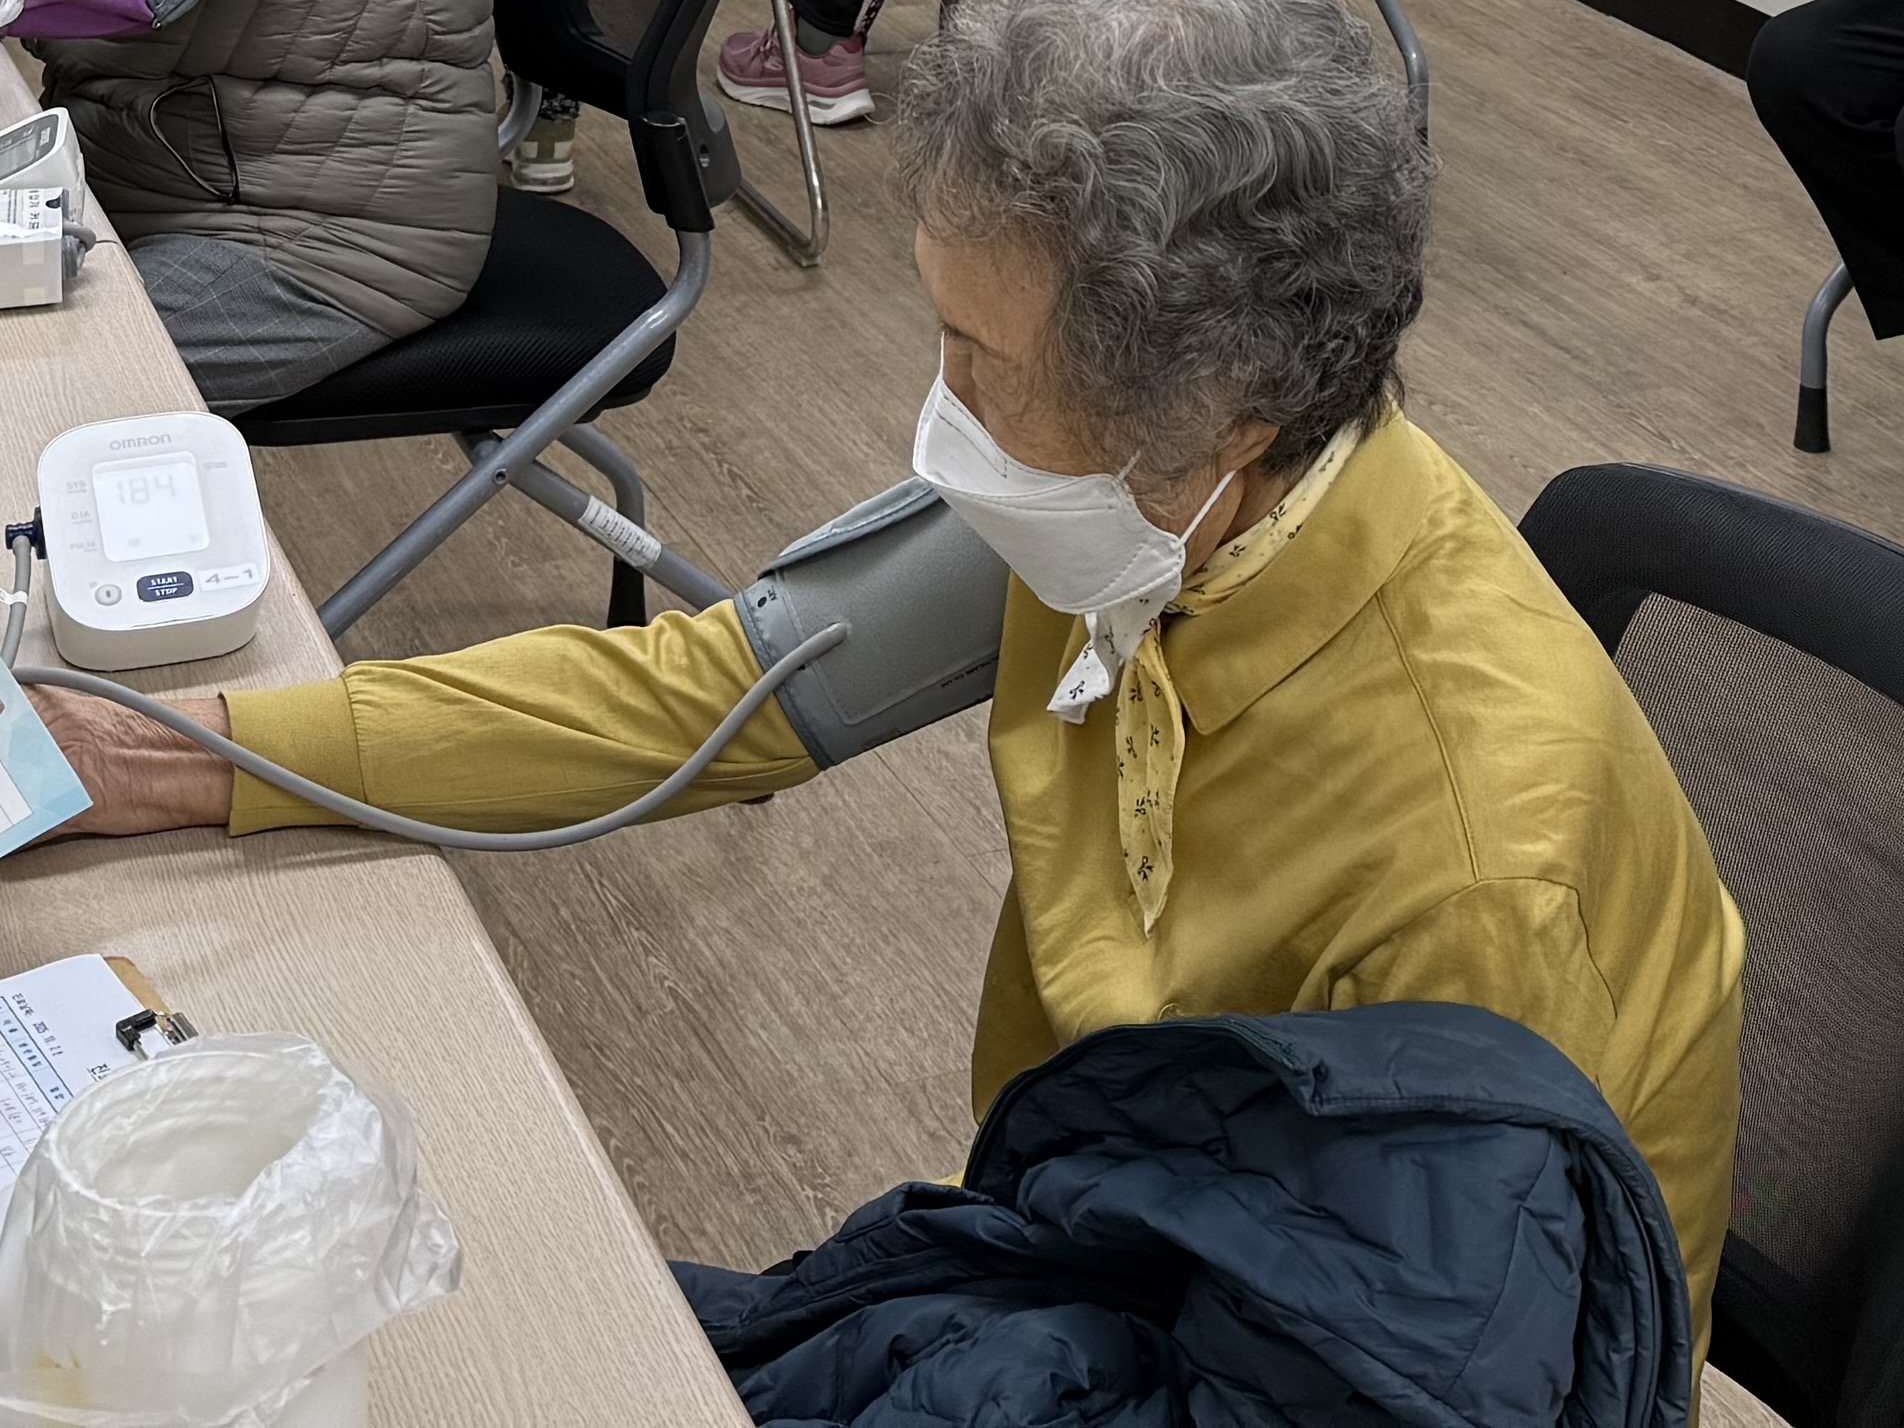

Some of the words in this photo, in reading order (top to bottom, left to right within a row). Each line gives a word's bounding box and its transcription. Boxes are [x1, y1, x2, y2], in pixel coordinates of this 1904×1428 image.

[109, 433, 172, 451] OMRON
[117, 473, 177, 505] 184
[150, 576, 178, 587] START
[155, 587, 178, 597] STOP
